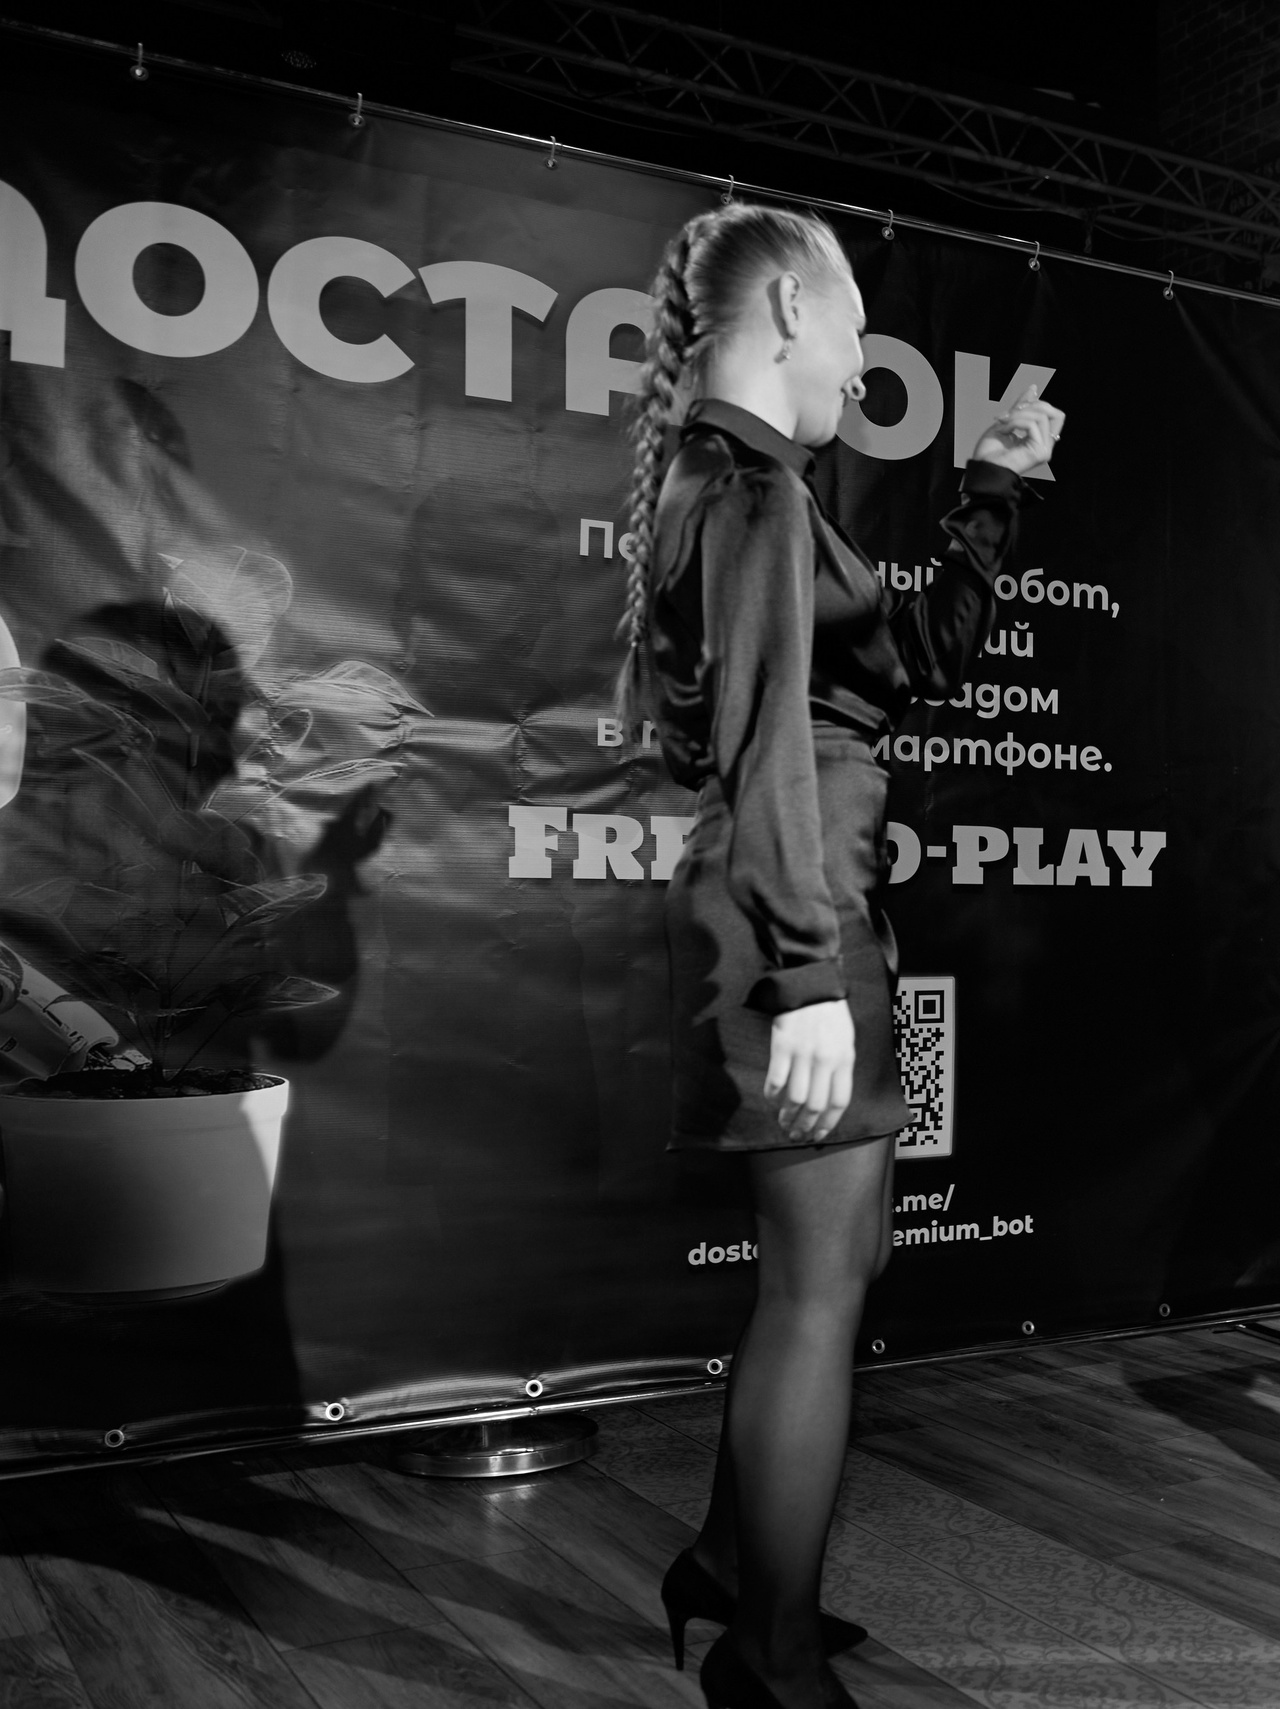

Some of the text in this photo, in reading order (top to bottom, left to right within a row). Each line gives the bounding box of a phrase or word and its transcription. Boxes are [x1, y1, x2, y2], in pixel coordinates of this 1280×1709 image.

[0, 178, 1058, 482] ОСТАОК
[993, 567, 1120, 619] обот,
[870, 731, 1113, 777] мартфоне.
